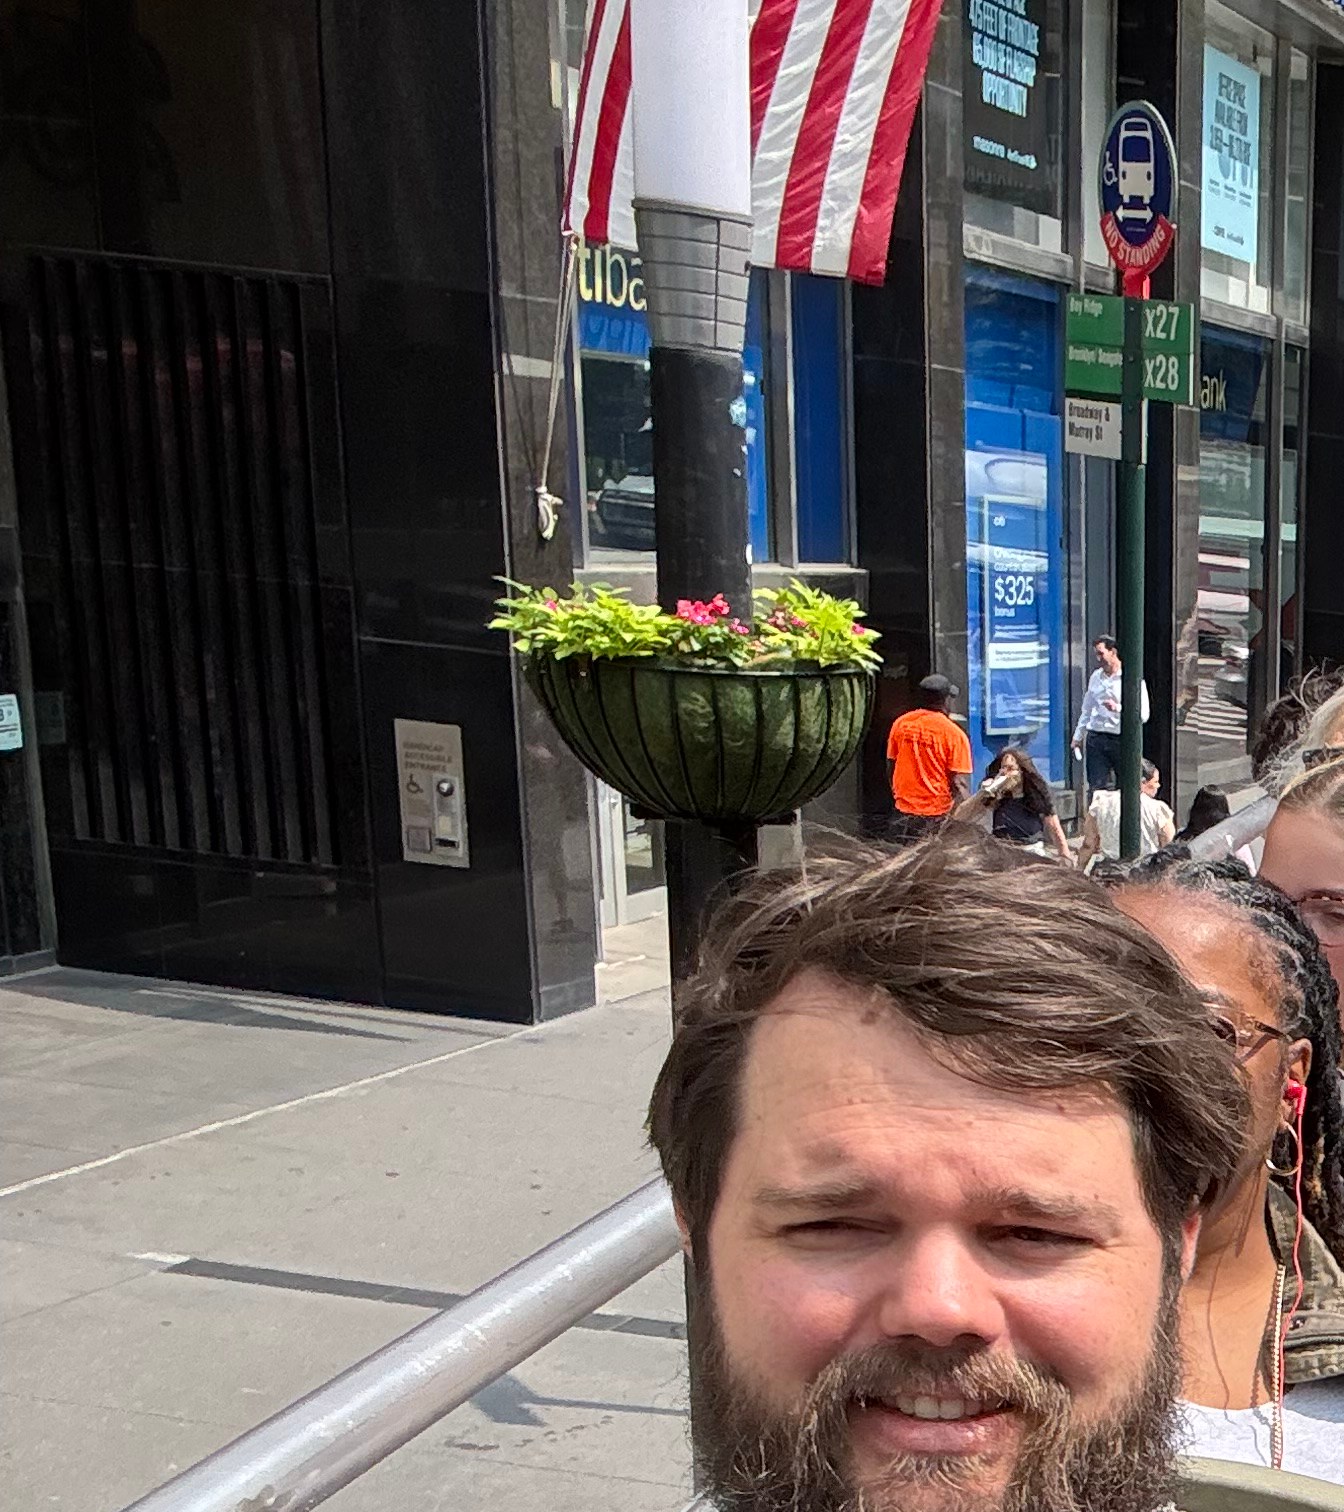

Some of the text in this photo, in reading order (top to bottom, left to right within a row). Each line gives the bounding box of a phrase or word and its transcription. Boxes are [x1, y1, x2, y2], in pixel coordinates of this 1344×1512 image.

[1104, 220, 1166, 267] NO STANDING
[1201, 369, 1227, 412] ank
[1069, 402, 1110, 423] Broadway &
[1069, 421, 1103, 442] Murray St
[994, 574, 1034, 606] $325
